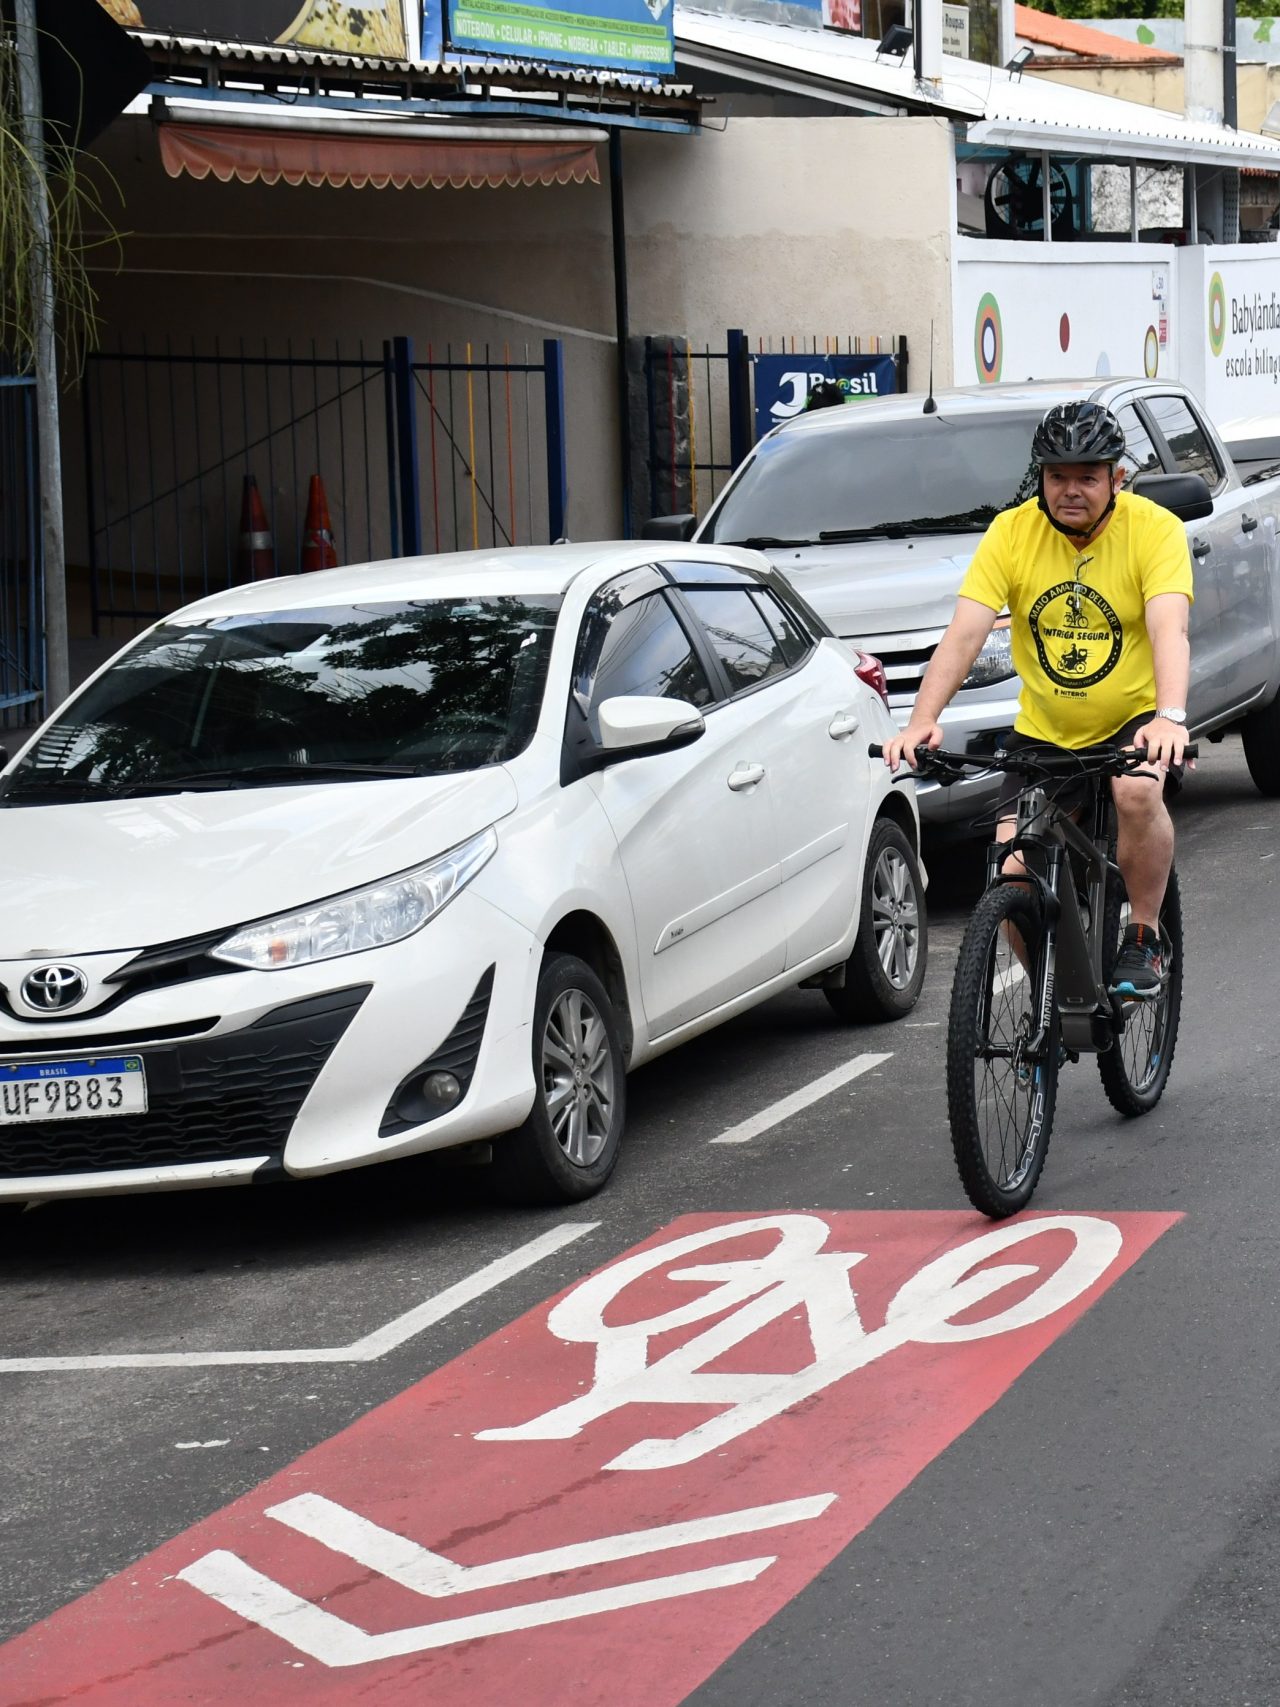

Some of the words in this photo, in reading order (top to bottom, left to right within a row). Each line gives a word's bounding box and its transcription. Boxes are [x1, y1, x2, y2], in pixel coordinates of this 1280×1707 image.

[456, 17, 496, 38] NOTEBOOK
[501, 24, 534, 43] CELULAR
[538, 29, 564, 48] IPHONE
[567, 34, 600, 52] NOBREAK
[603, 39, 628, 57] TABLET
[631, 43, 670, 60] IMPRESSORA
[1231, 291, 1280, 343] Babylândia
[1225, 349, 1252, 378] escola
[1030, 596, 1049, 620] MAIO
[1088, 590, 1119, 628] DELIVERY
[1076, 632, 1110, 641] SEGURA
[39, 1068, 69, 1077] BRASIL
[0, 1076, 124, 1116] UF9B83
